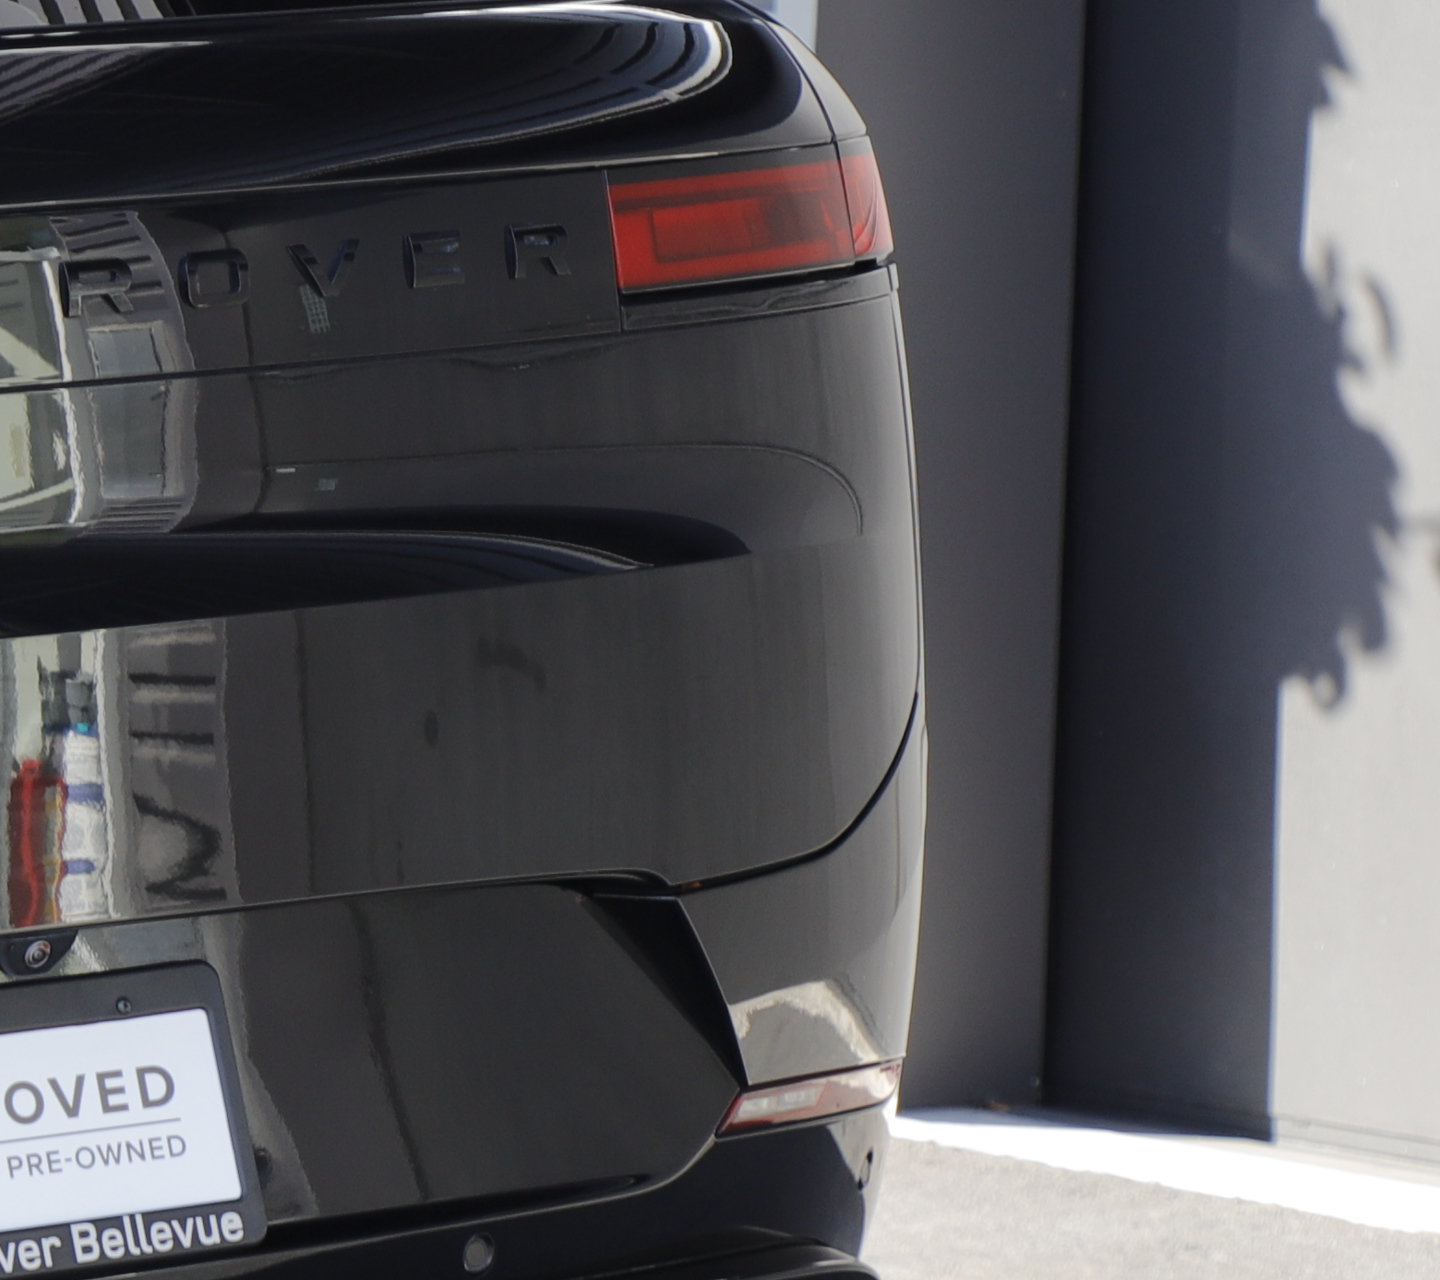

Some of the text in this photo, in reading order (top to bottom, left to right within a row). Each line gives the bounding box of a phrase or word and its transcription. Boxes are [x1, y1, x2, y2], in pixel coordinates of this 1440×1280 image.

[57, 221, 572, 319] ROVER
[6, 1133, 188, 1181] PRE-OWNED
[68, 1210, 244, 1263] Bellevue
